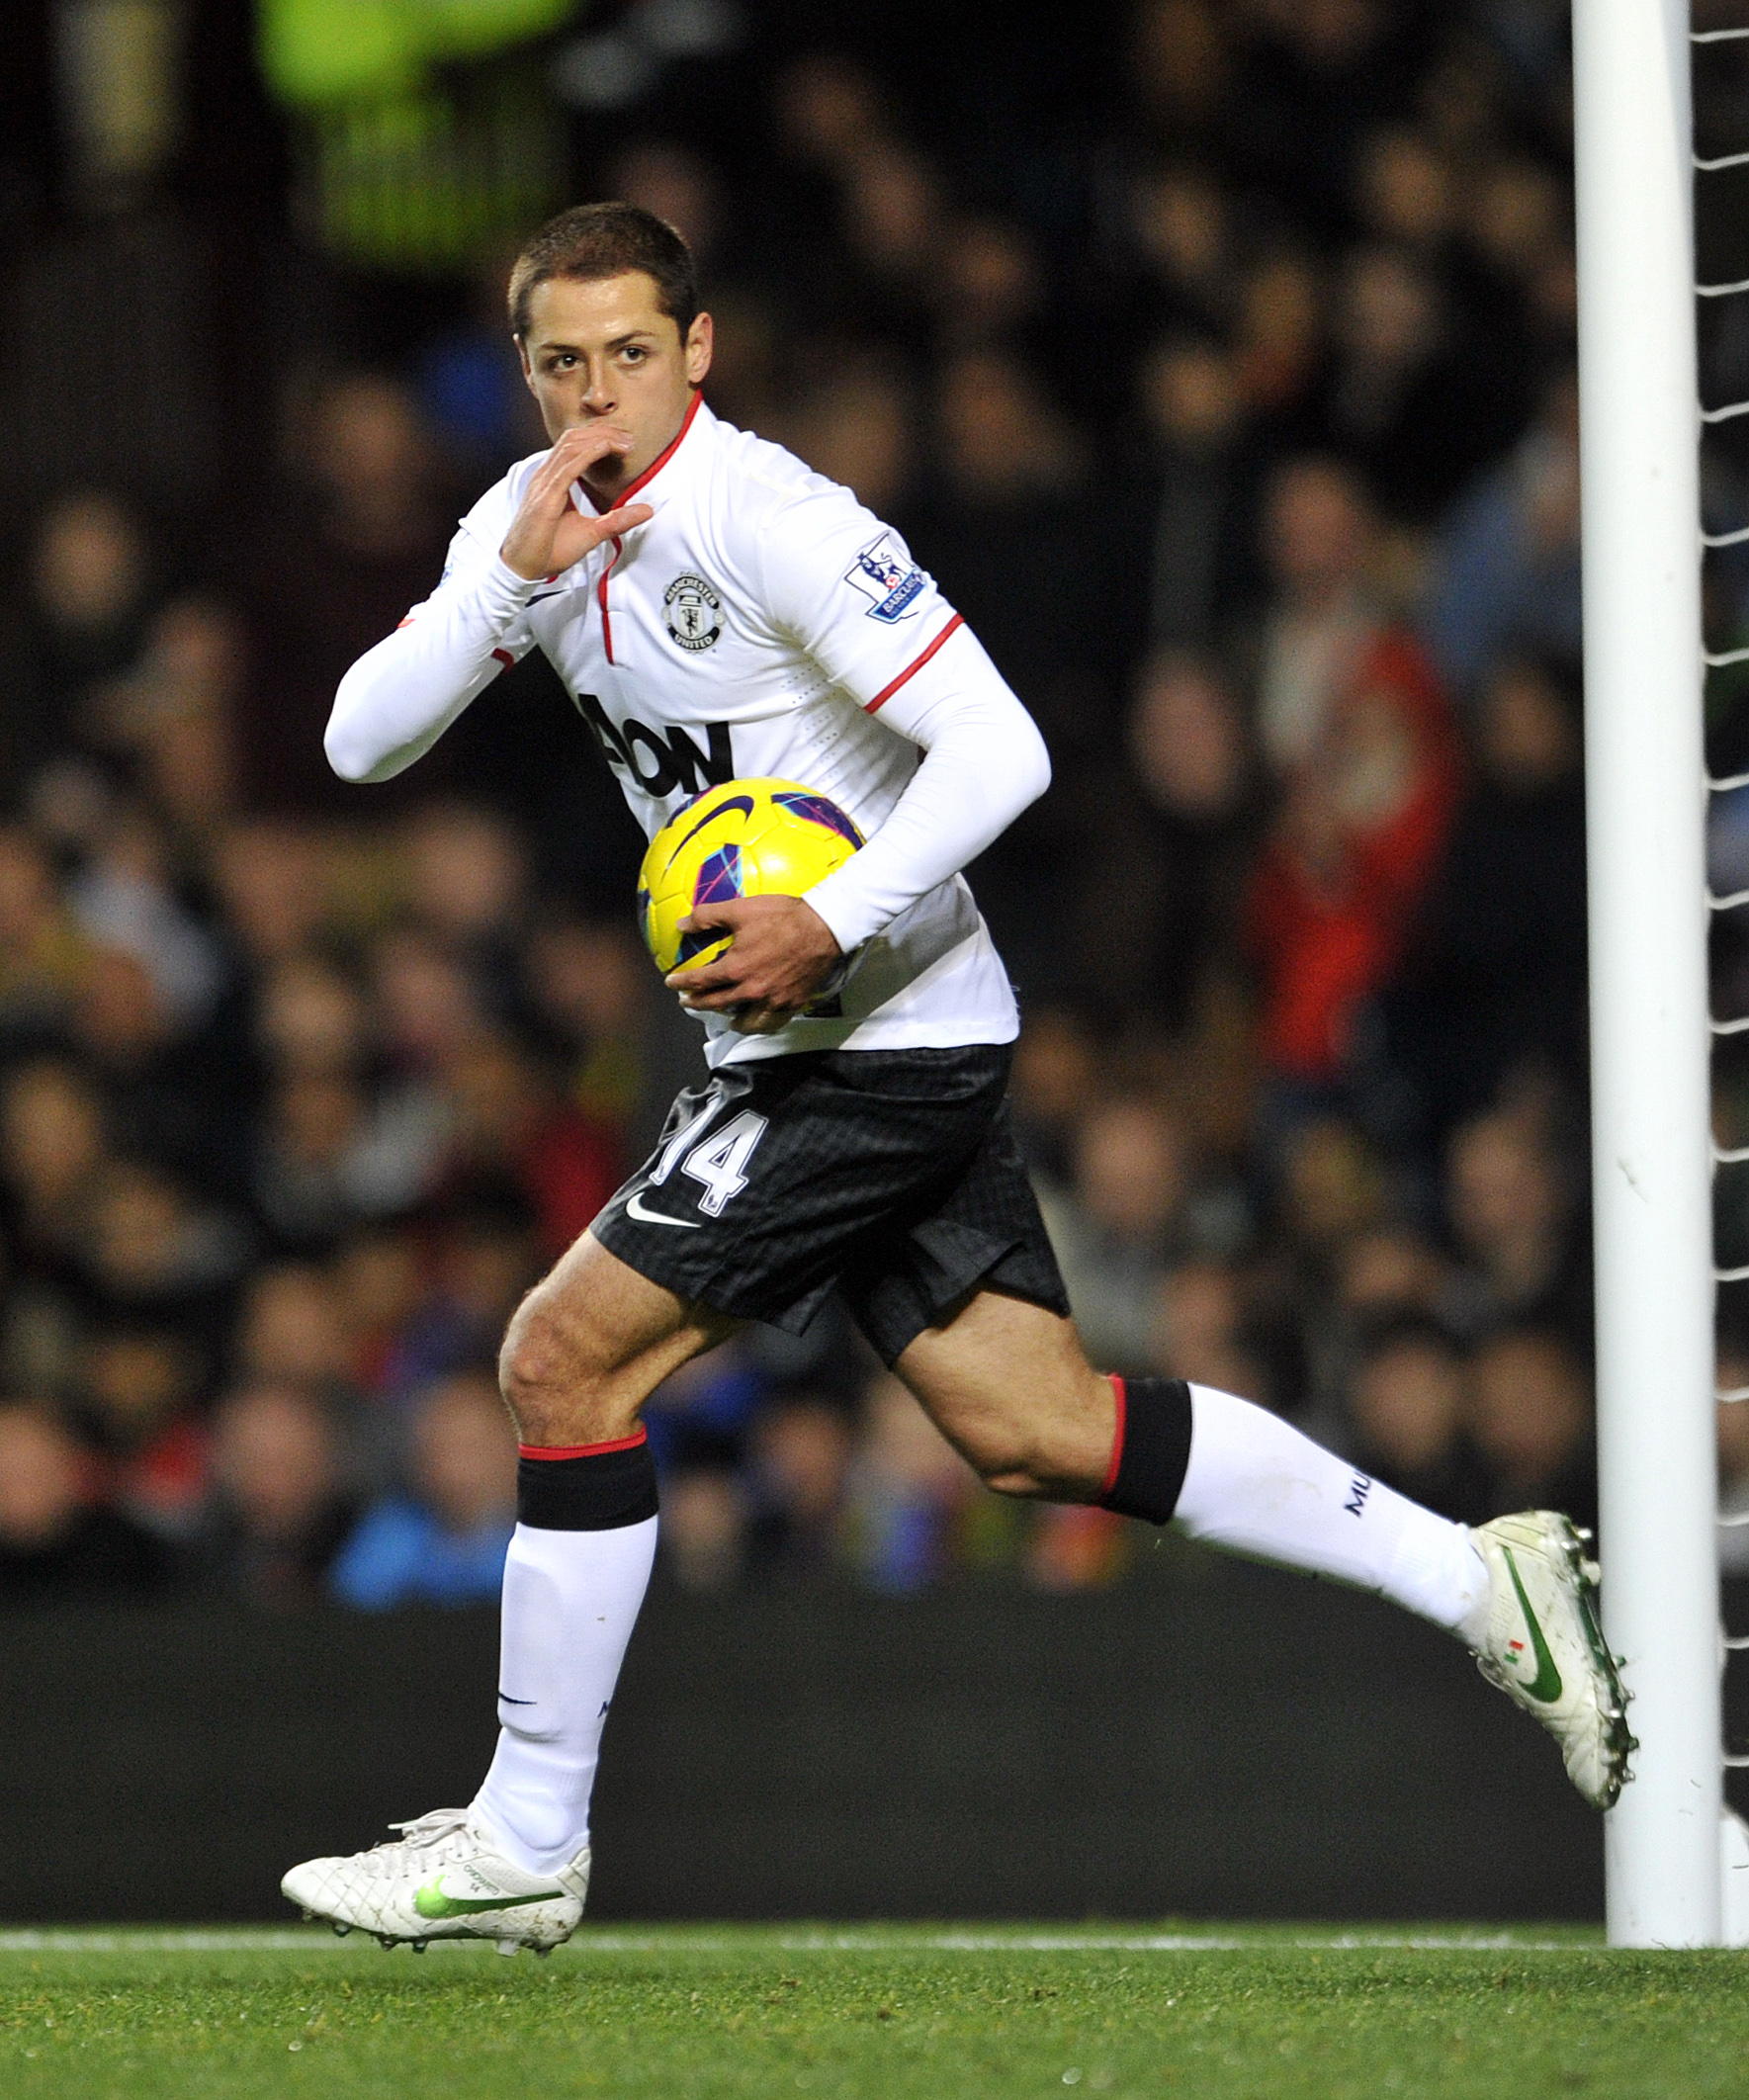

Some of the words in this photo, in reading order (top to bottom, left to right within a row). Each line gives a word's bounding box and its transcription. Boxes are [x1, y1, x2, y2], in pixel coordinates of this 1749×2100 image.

[674, 633, 713, 649] UNITED
[578, 693, 735, 798] AON
[649, 1092, 769, 1218] 14
[1344, 1471, 1371, 1518] MU
